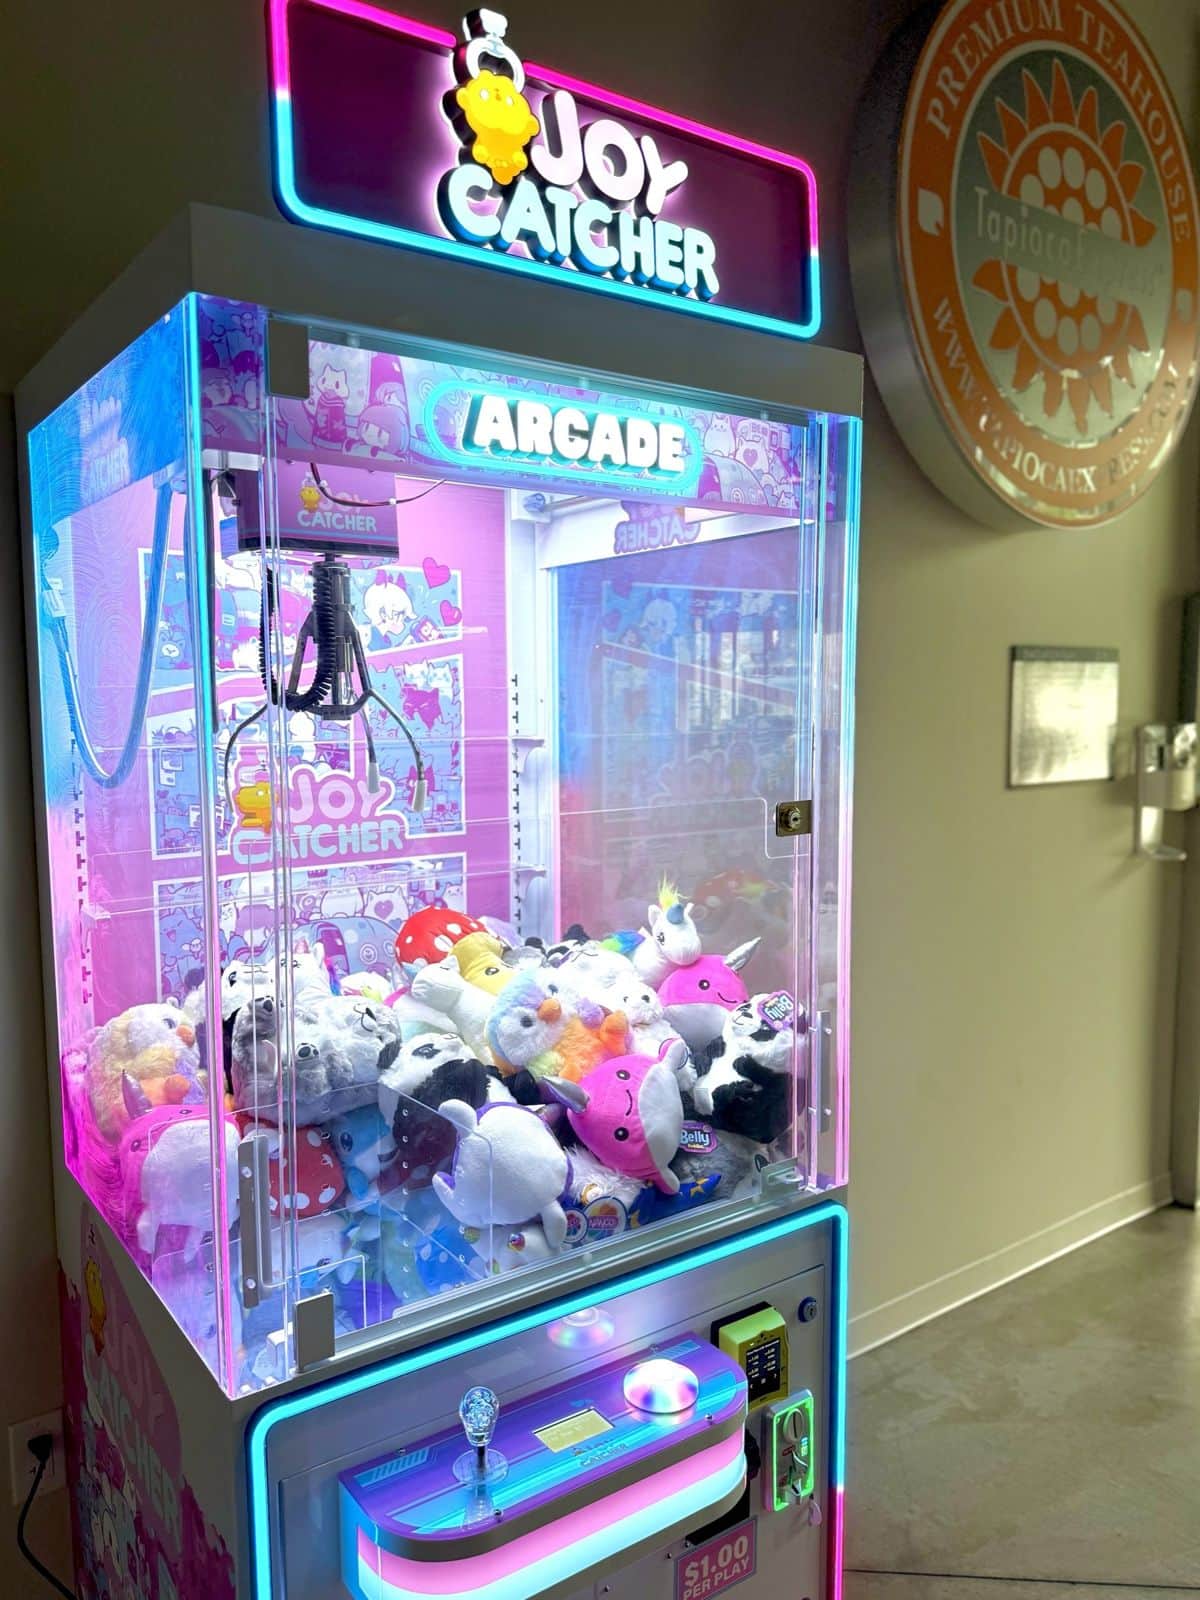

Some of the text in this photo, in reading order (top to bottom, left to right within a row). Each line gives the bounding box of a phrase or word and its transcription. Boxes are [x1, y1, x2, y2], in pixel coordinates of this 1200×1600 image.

[927, 0, 1192, 242] PREMIUM TEAHOUSE
[531, 89, 689, 214] JOY
[445, 164, 720, 297] CATCHER
[471, 395, 686, 473] ARCADE
[297, 510, 377, 532] CATCHER
[278, 774, 387, 824] JOY
[764, 995, 793, 1020] Belly
[680, 1129, 710, 1146] Belly
[683, 1555, 749, 1600] PER PLAY
[684, 1535, 749, 1587] $1.00
